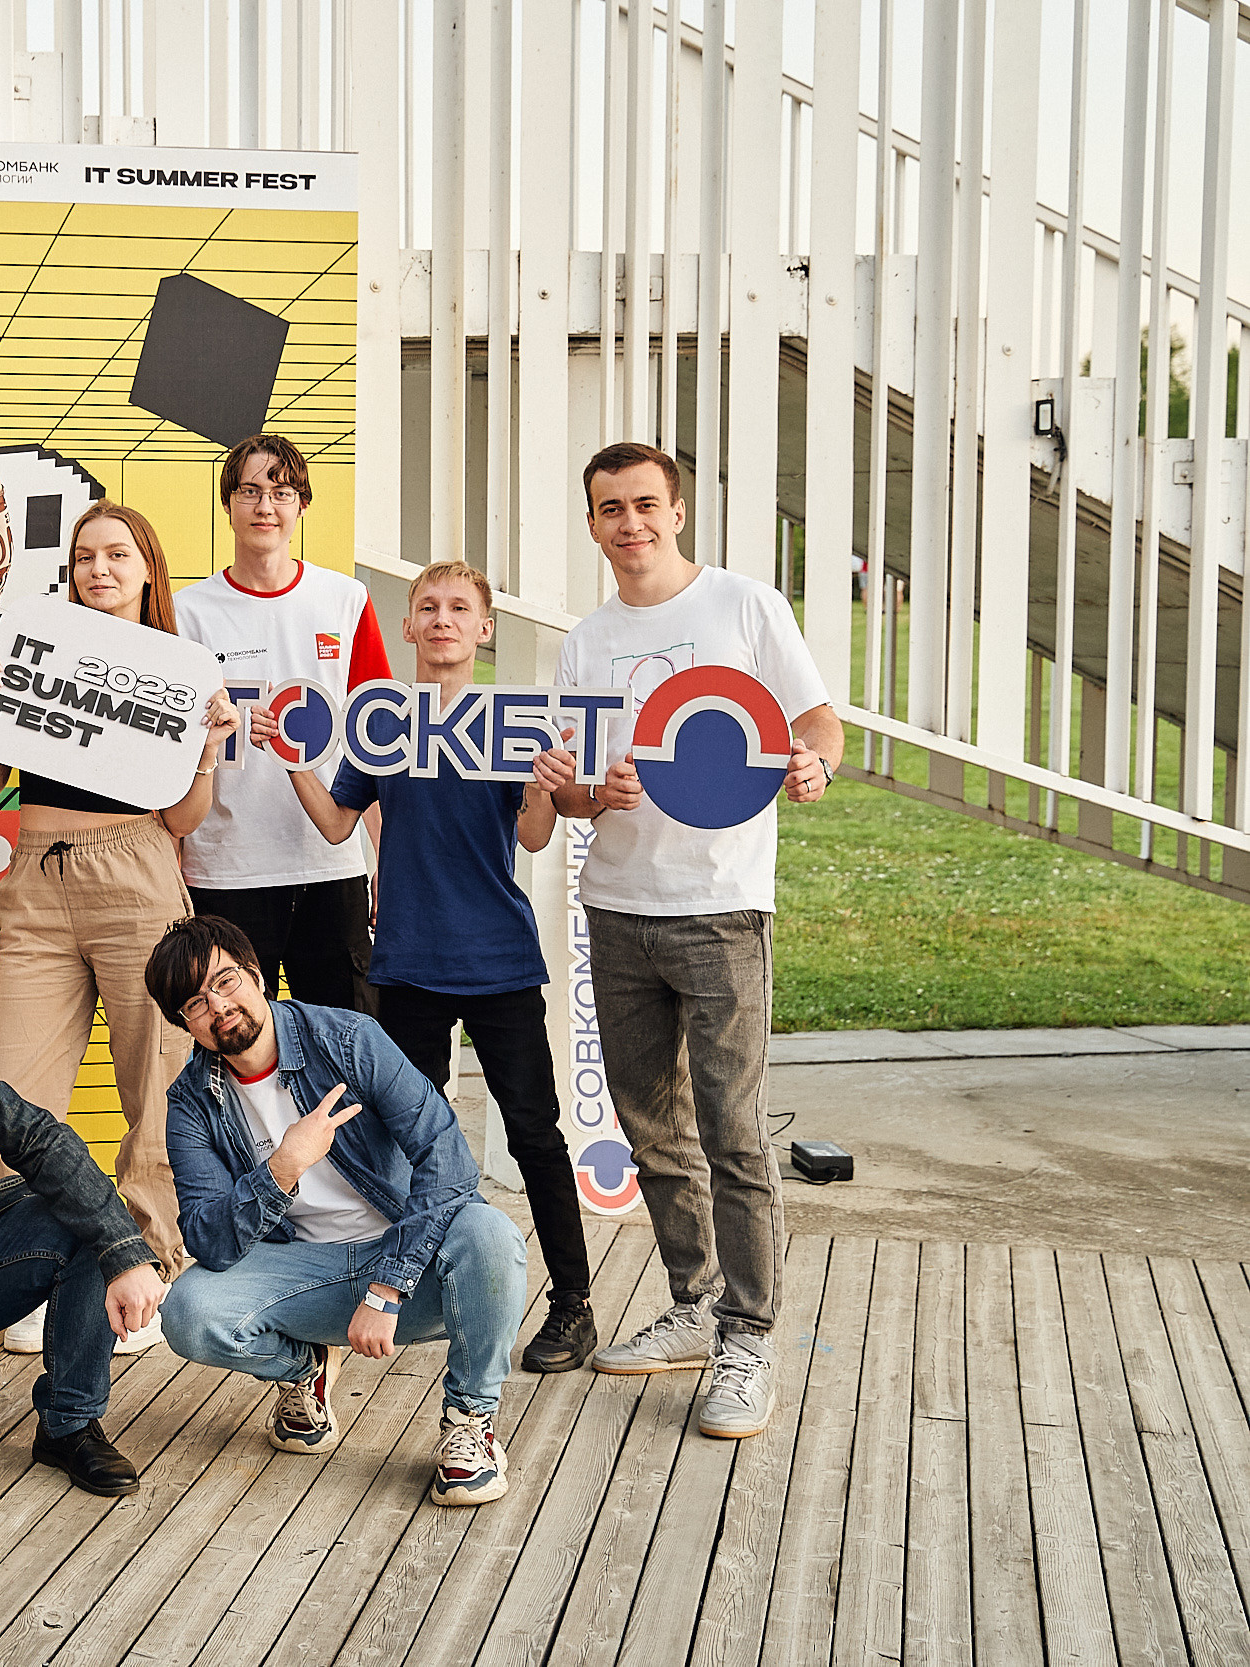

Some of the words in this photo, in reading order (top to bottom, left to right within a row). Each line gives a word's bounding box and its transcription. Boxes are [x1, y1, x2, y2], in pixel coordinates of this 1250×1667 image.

[85, 166, 110, 183] IT
[117, 168, 239, 188] SUMMER
[245, 172, 317, 191] FEST
[11, 634, 55, 665] IT
[1, 664, 187, 743] SUMMER
[74, 656, 197, 712] 2023
